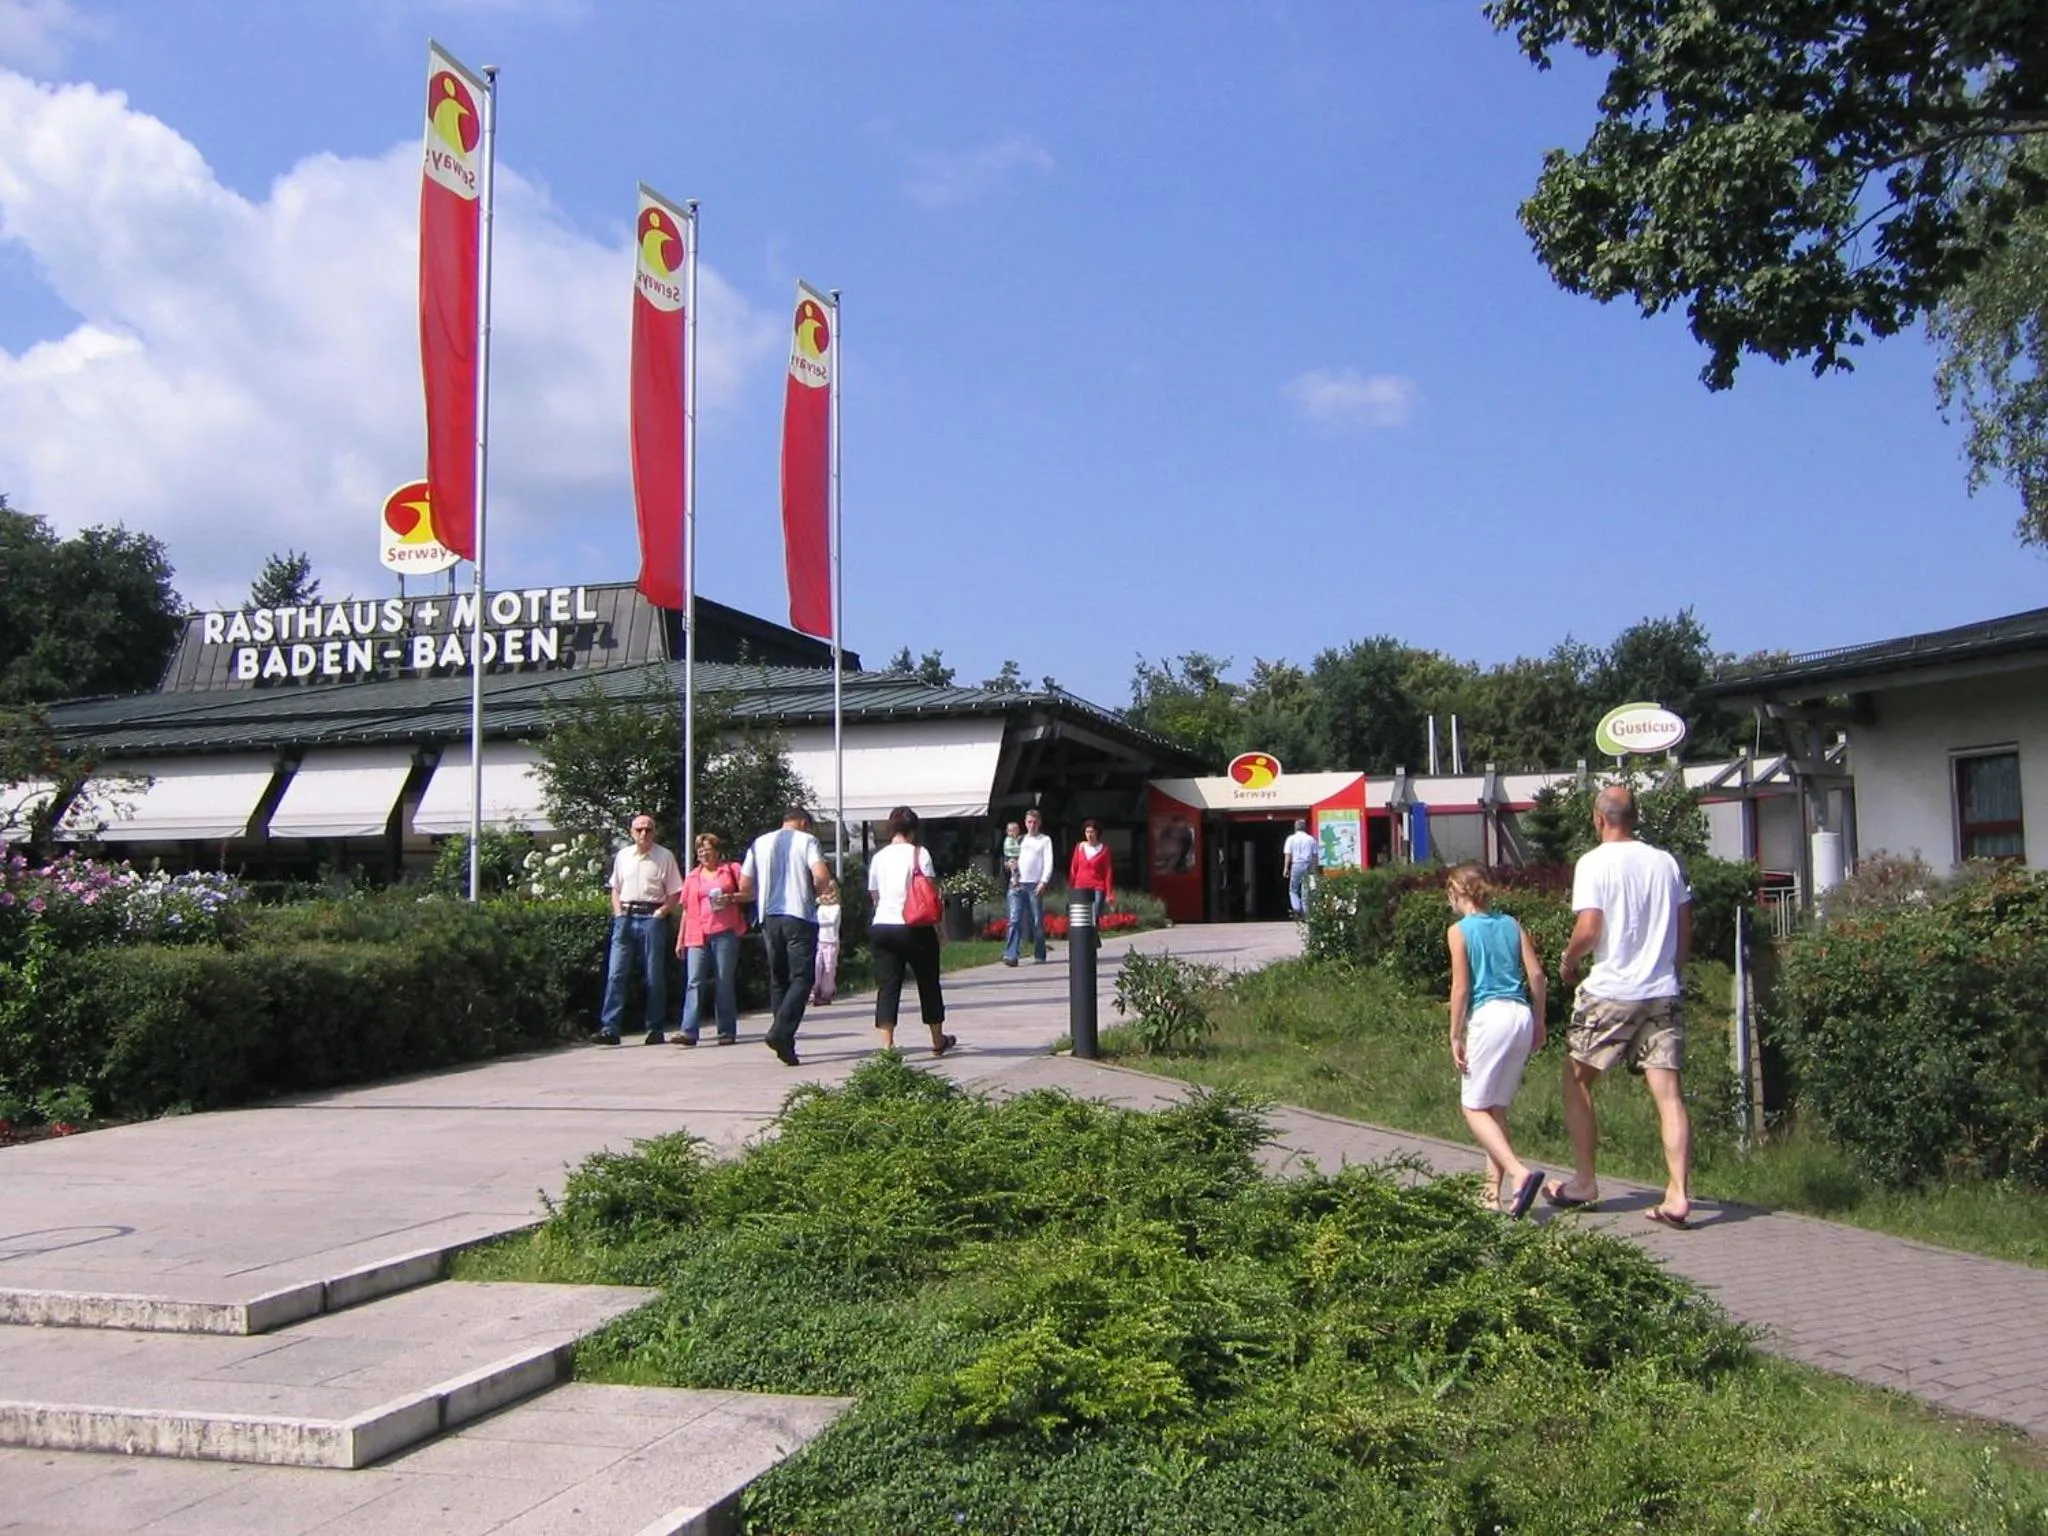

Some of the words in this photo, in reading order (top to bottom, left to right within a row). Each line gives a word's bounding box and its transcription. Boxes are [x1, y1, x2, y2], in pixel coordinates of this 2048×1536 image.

[203, 599, 404, 645] RASTHAUS
[418, 601, 440, 627] +
[452, 586, 597, 628] MOTEL
[1611, 719, 1677, 737] Gusticus
[1233, 789, 1277, 799] Serways
